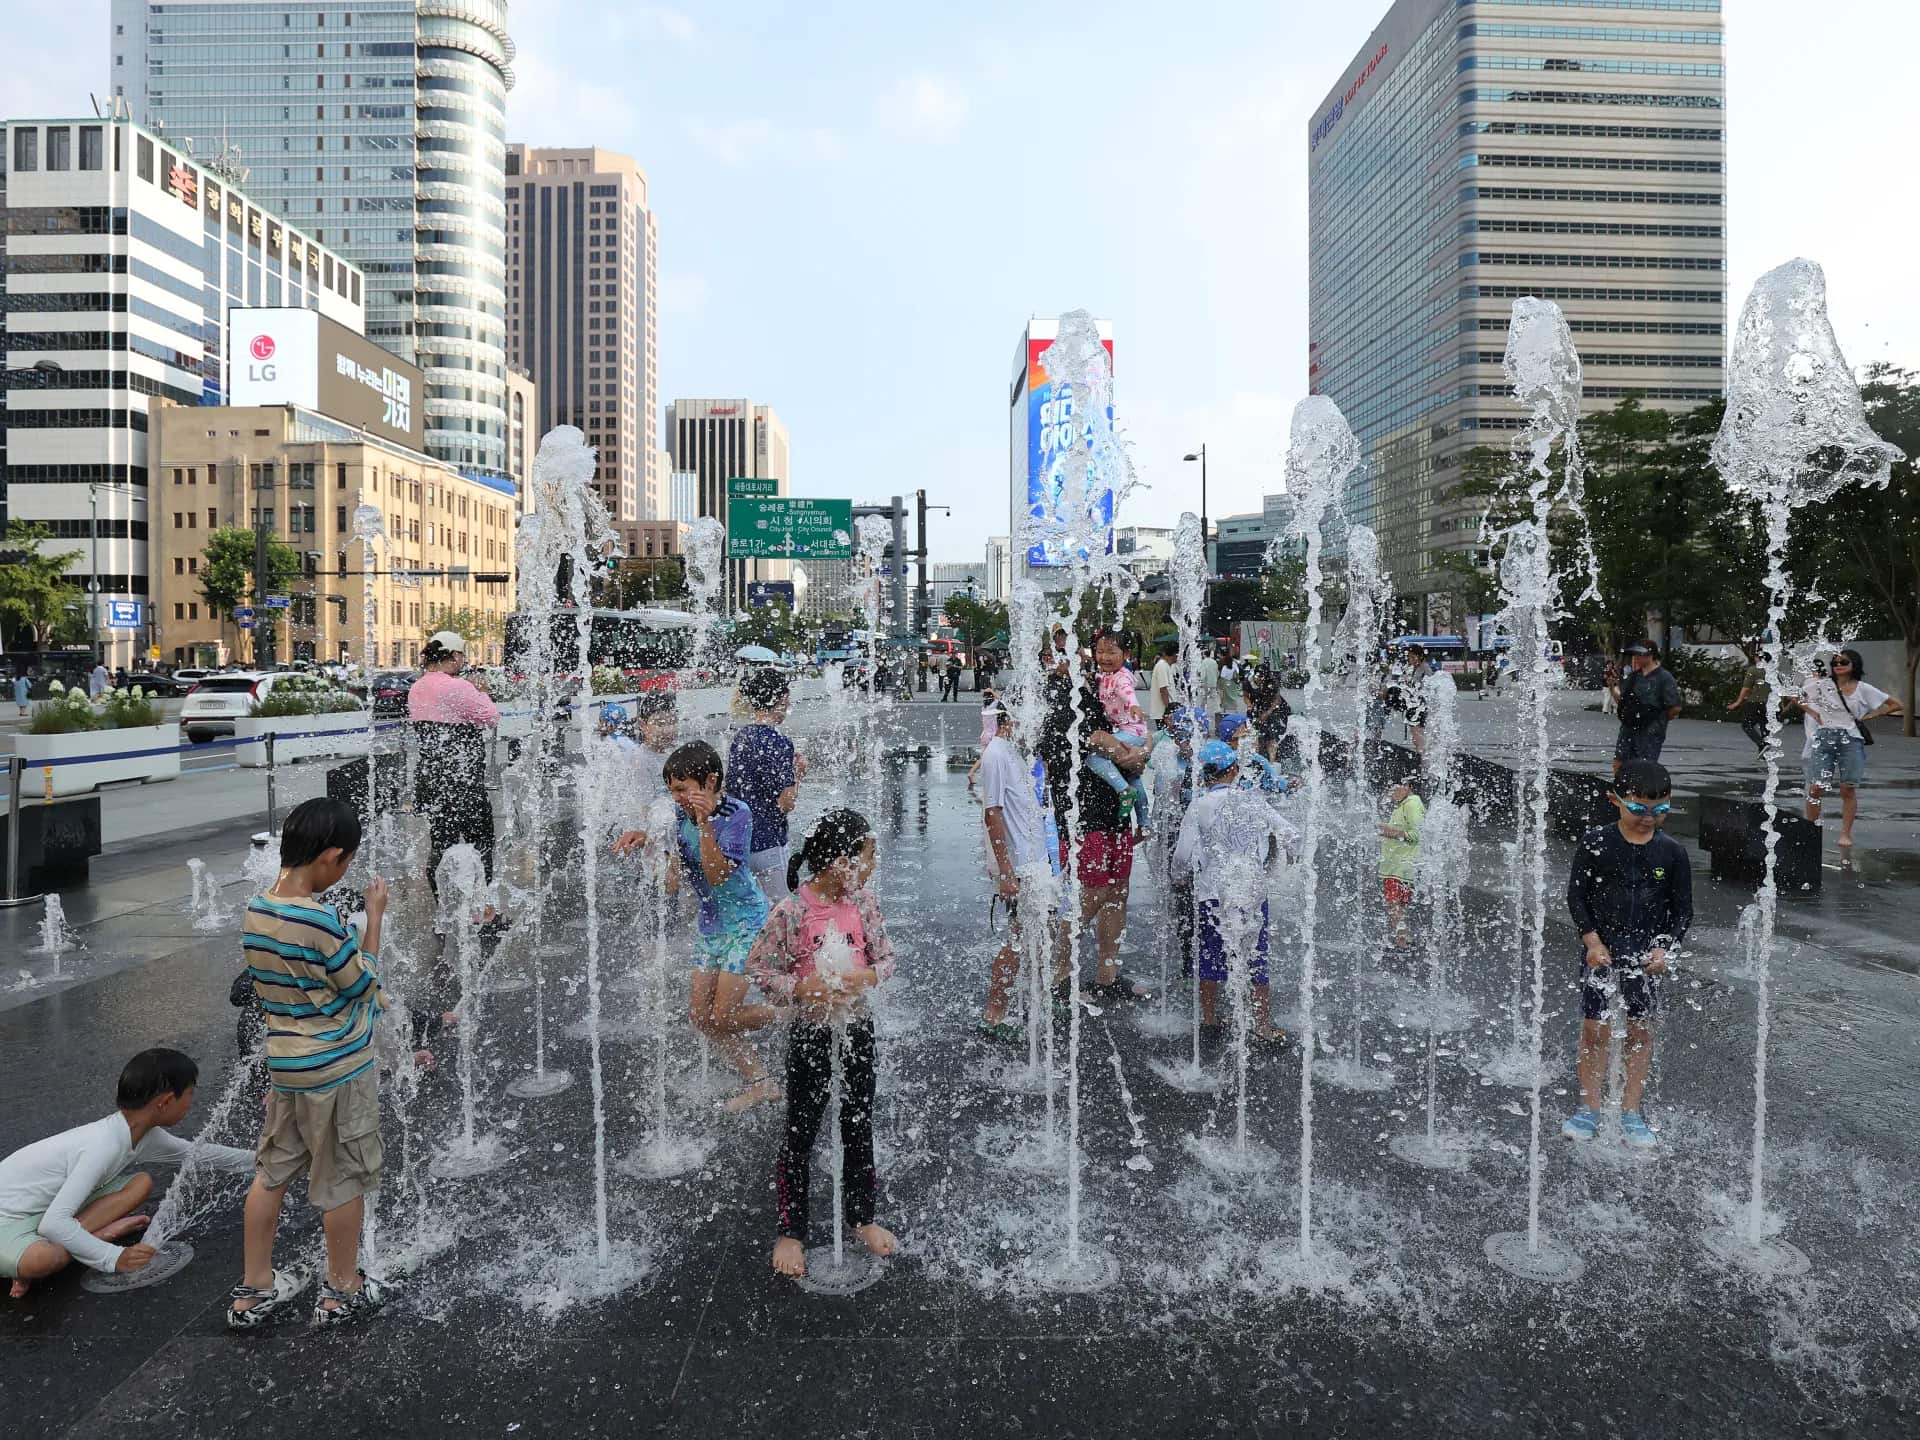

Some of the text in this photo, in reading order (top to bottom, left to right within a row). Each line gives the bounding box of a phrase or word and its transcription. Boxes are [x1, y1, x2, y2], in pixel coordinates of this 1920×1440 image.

[249, 365, 276, 381] LG
[382, 367, 410, 406] 미래
[382, 395, 410, 432] 가치
[759, 503, 785, 512] 숭례문
[789, 509, 827, 517] Sungnyemun
[798, 526, 809, 534] City
[731, 539, 766, 549] 종로1가
